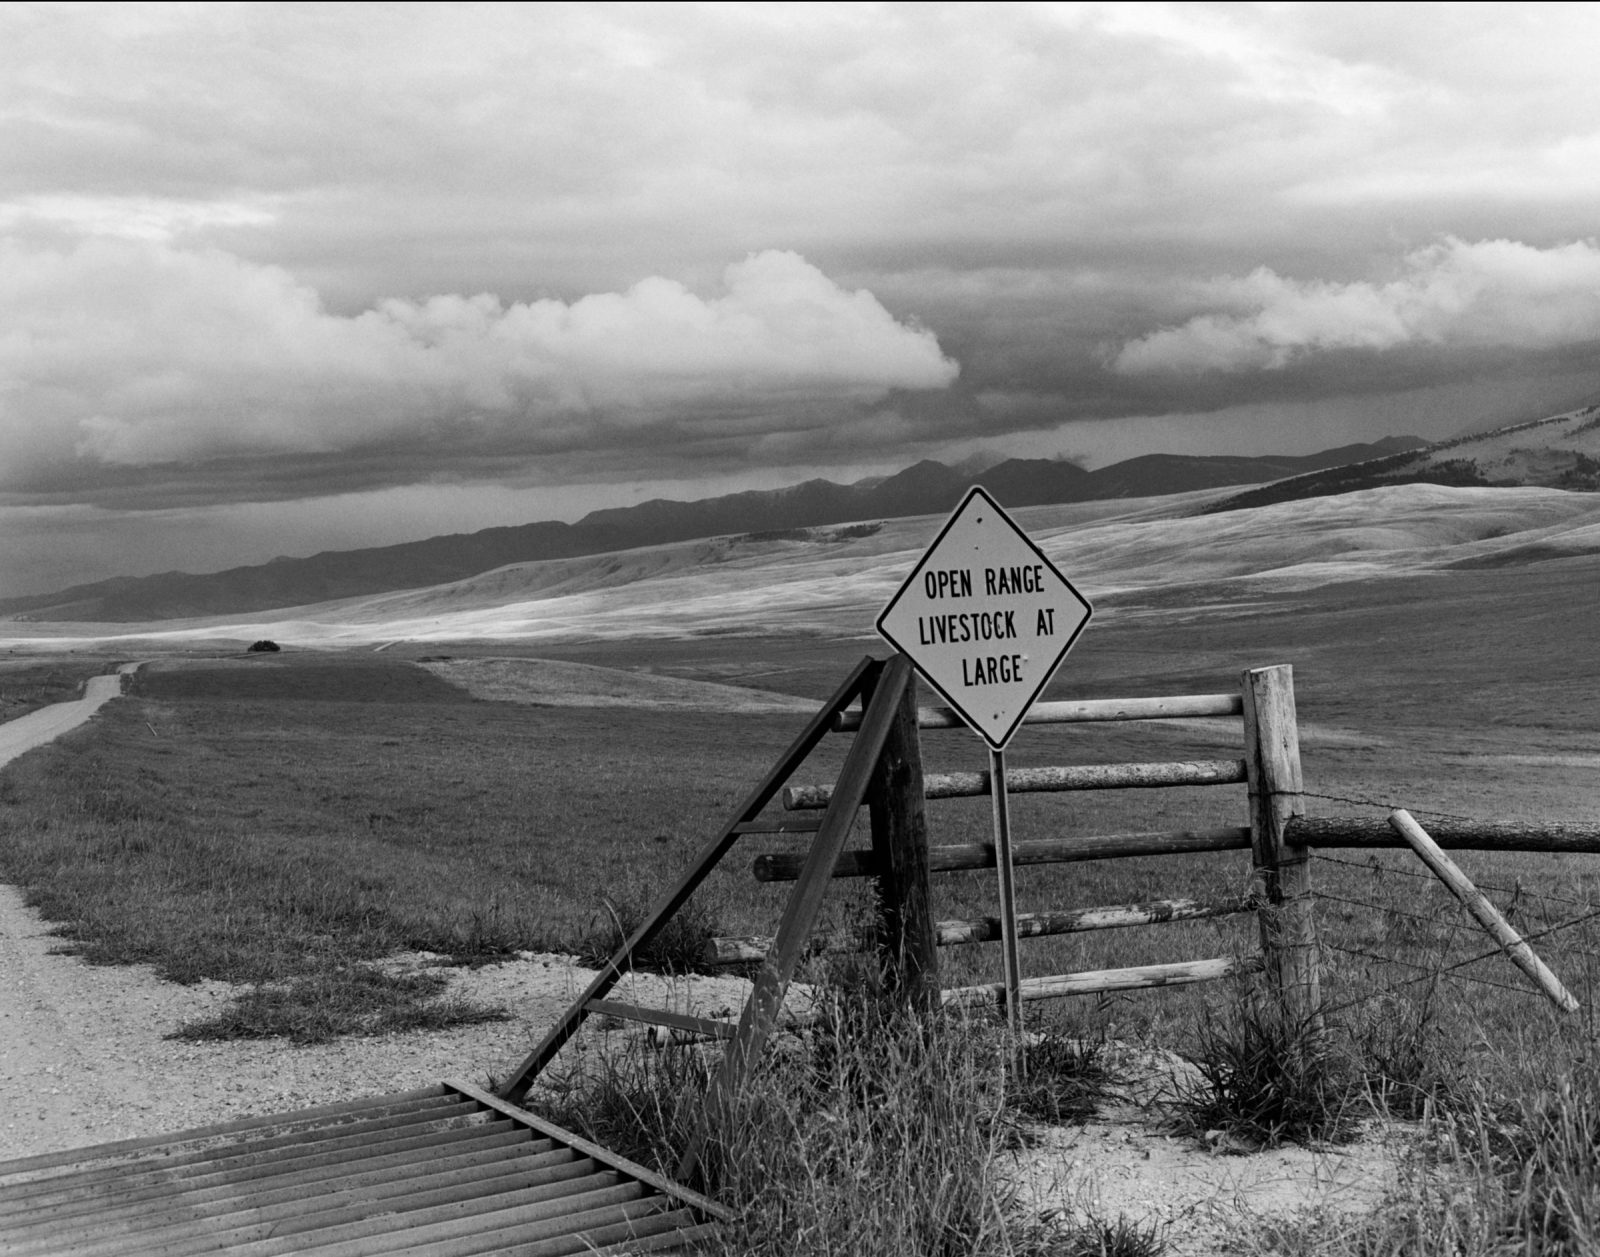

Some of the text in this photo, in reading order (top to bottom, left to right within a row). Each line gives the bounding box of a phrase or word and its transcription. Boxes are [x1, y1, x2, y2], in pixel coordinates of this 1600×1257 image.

[924, 564, 1045, 600] OPEN RANGE
[918, 608, 1055, 646] LIVESTOCK AT
[962, 654, 1023, 687] LARGE
